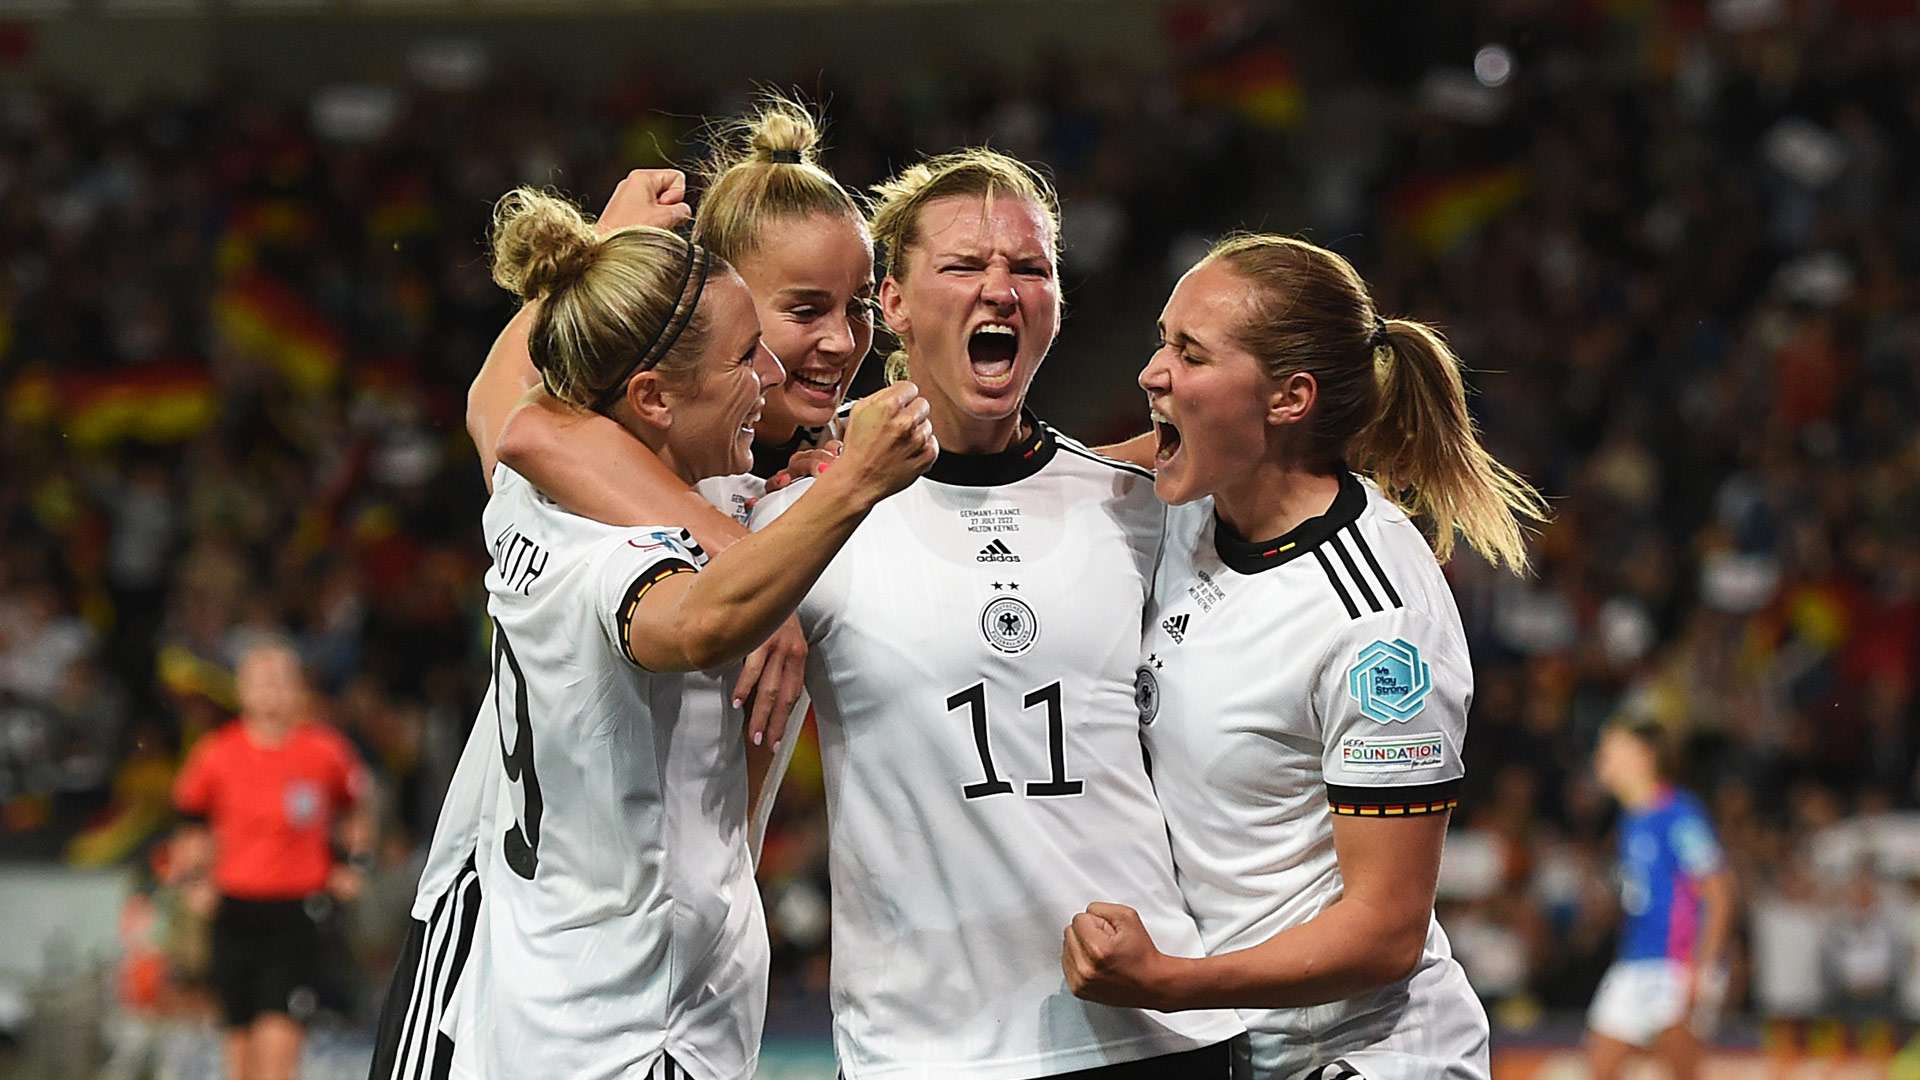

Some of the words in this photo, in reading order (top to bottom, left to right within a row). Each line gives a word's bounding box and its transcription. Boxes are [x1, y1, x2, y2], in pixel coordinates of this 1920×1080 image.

[960, 509, 1020, 517] GERMANY-FRANCE
[976, 553, 1021, 562] adidas
[1375, 676, 1397, 686] Play
[1375, 685, 1408, 696] Strong
[946, 680, 1083, 799] 11
[1343, 739, 1364, 748] UEFA
[494, 616, 544, 880] 9
[1343, 744, 1442, 760] FOUNDATION
